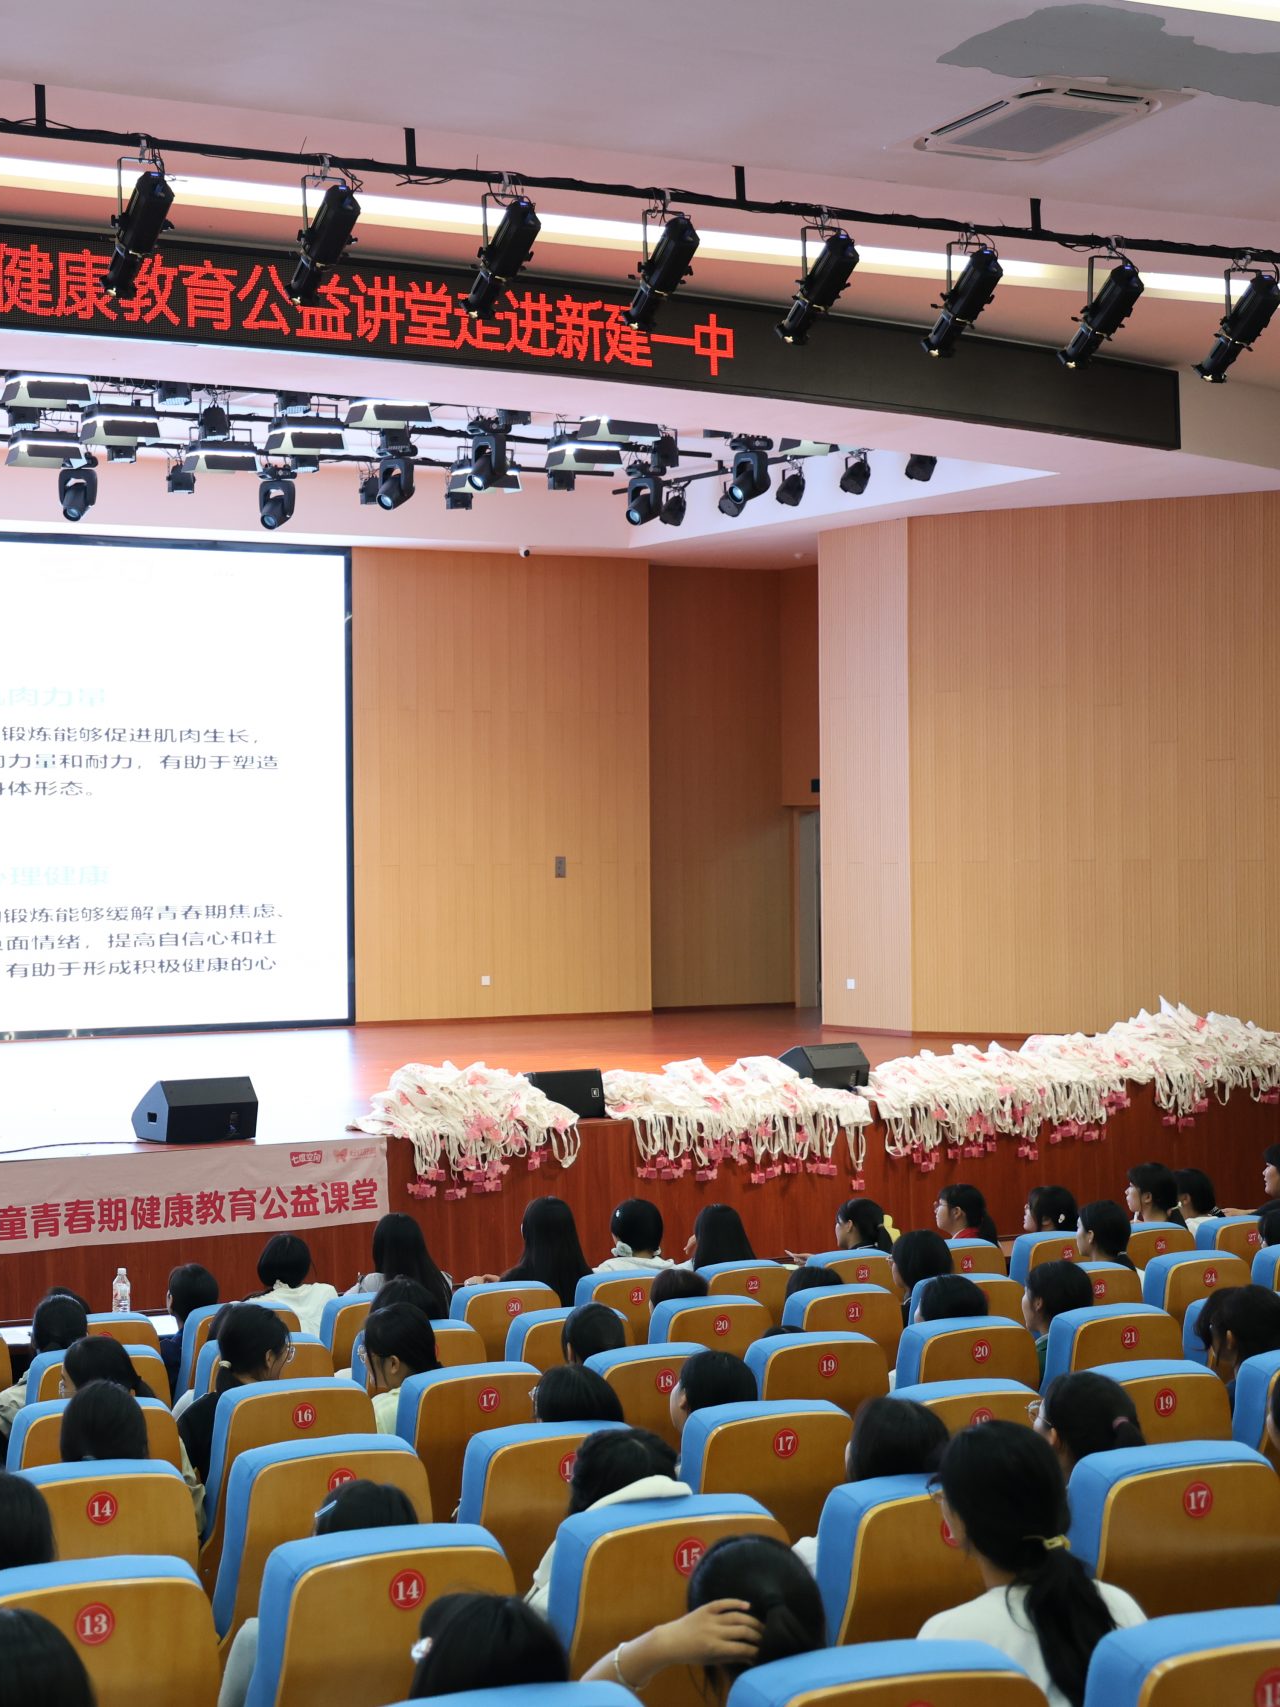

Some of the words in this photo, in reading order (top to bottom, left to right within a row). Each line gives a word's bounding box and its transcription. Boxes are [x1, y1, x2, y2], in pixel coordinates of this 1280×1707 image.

[1206, 1273, 1215, 1282] 24
[749, 1281, 758, 1289] 22
[1095, 1284, 1105, 1294] 23
[633, 1292, 642, 1300] 21
[509, 1303, 519, 1311] 20
[849, 1308, 859, 1317] 21
[717, 1320, 728, 1330] 20
[1125, 1332, 1135, 1343] 21
[976, 1346, 988, 1357] 20
[823, 1360, 834, 1371] 19
[661, 1375, 672, 1387] 18
[483, 1394, 496, 1406] 17
[1160, 1396, 1173, 1409] 19
[298, 1409, 312, 1422] 16
[779, 1436, 793, 1451] 17
[1190, 1491, 1207, 1509] 17
[93, 1501, 111, 1517] 14
[682, 1548, 702, 1567] 15
[397, 1580, 419, 1600] 14
[84, 1614, 107, 1635] 13
